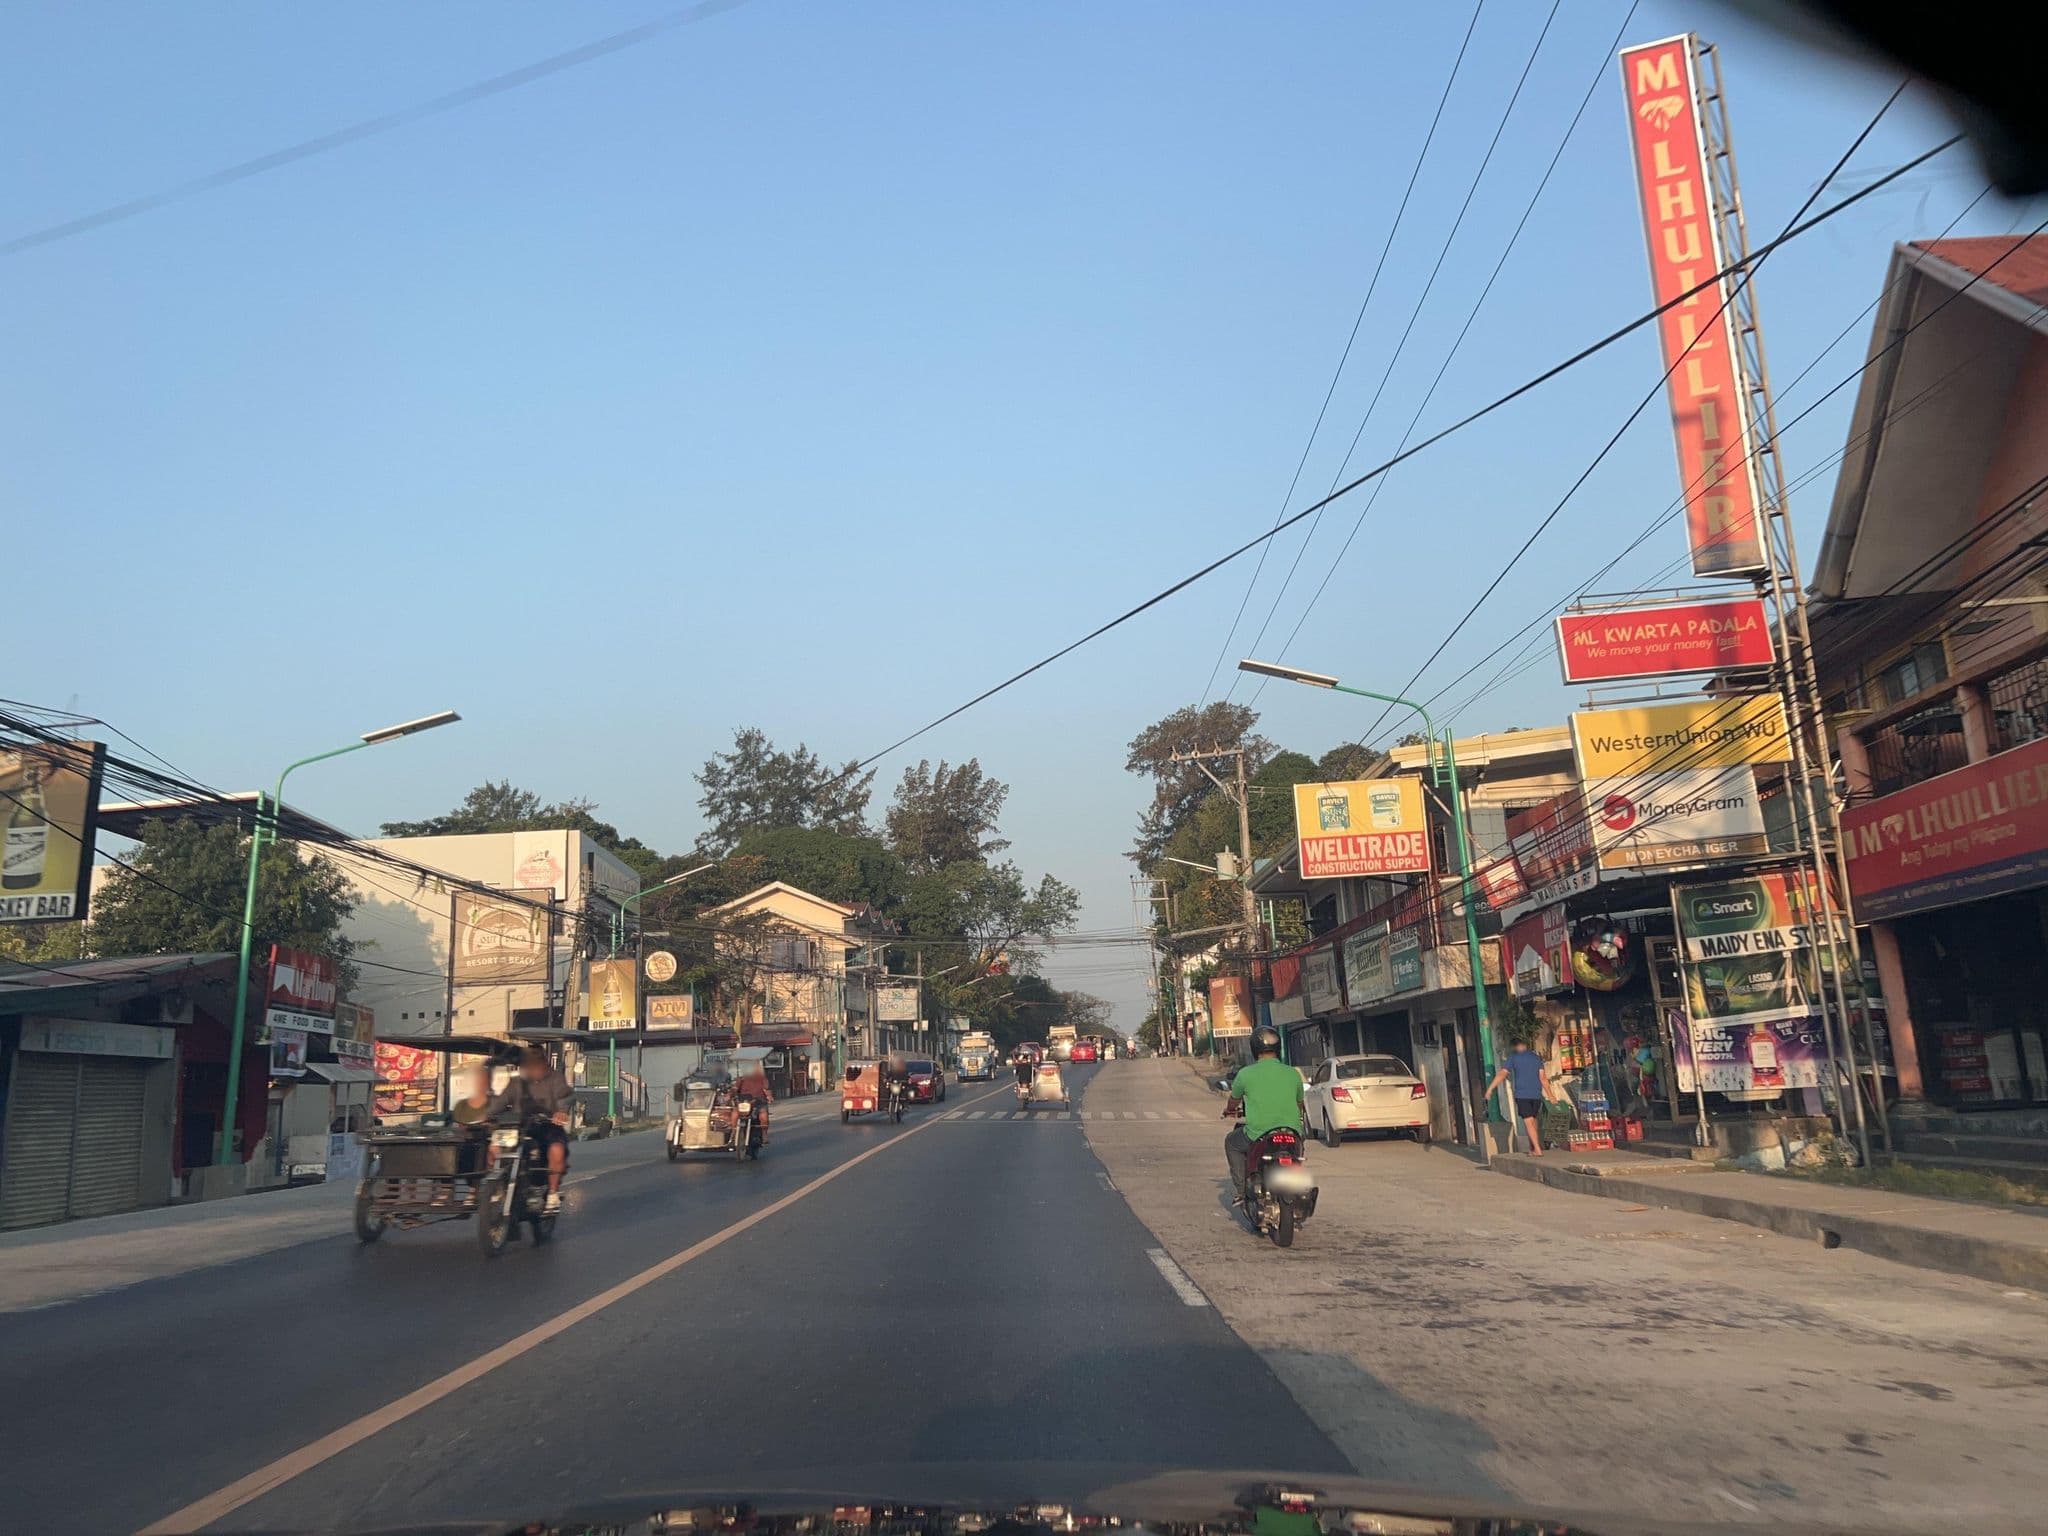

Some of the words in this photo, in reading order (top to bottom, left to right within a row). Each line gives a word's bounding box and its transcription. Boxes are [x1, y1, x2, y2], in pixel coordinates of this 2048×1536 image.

[1636, 52, 1681, 96] M
[1653, 139, 1743, 536] LHUILLIER
[1573, 631, 1599, 647] ML
[1604, 622, 1681, 644] KWARTA
[1688, 616, 1757, 635] PADALA
[1587, 646, 1606, 658] We
[1610, 645, 1641, 657] move
[1645, 642, 1670, 656] your
[1674, 638, 1713, 652] money
[1743, 720, 1776, 739] WU
[1638, 796, 1744, 817] MoneyGram
[1304, 833, 1424, 863] WELLTRADE
[1308, 859, 1382, 875] CONSTRUCTION
[1385, 857, 1422, 870] SUPPLY
[37, 896, 69, 916] BAR
[1712, 899, 1754, 914] Smart
[1700, 933, 1749, 958] MAIDY
[1753, 929, 1786, 951] ENA
[466, 956, 498, 967] RESORT
[654, 1002, 686, 1012] ATM
[593, 1020, 632, 1030] OUTBCK
[1695, 1027, 1733, 1040] BIG.
[1696, 1041, 1734, 1052] VERY
[1697, 1052, 1735, 1061] MOOTH.
